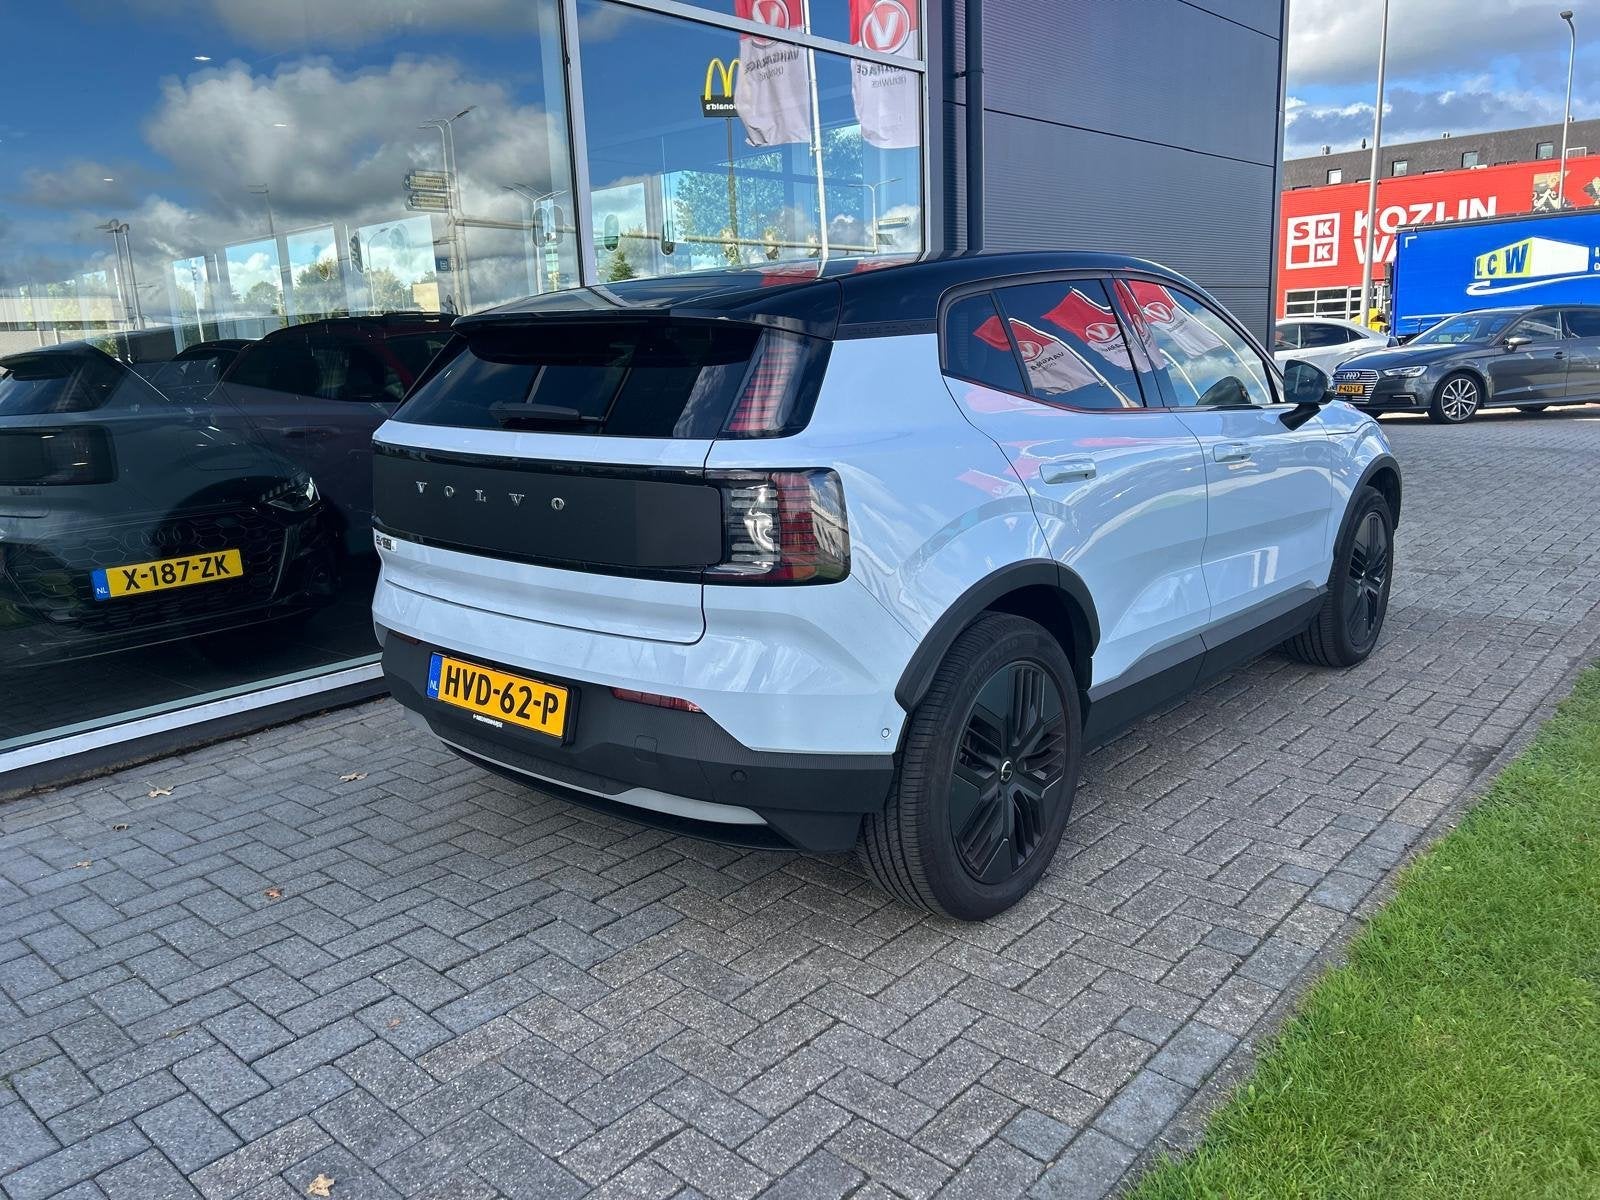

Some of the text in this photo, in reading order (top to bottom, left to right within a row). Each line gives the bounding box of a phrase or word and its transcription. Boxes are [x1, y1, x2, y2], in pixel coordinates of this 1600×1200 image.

[415, 481, 566, 511] VOLVO
[122, 554, 230, 591] X-187-ZK
[97, 587, 108, 595] NL
[429, 680, 438, 691] NL
[444, 665, 559, 725] HVD-62-P
